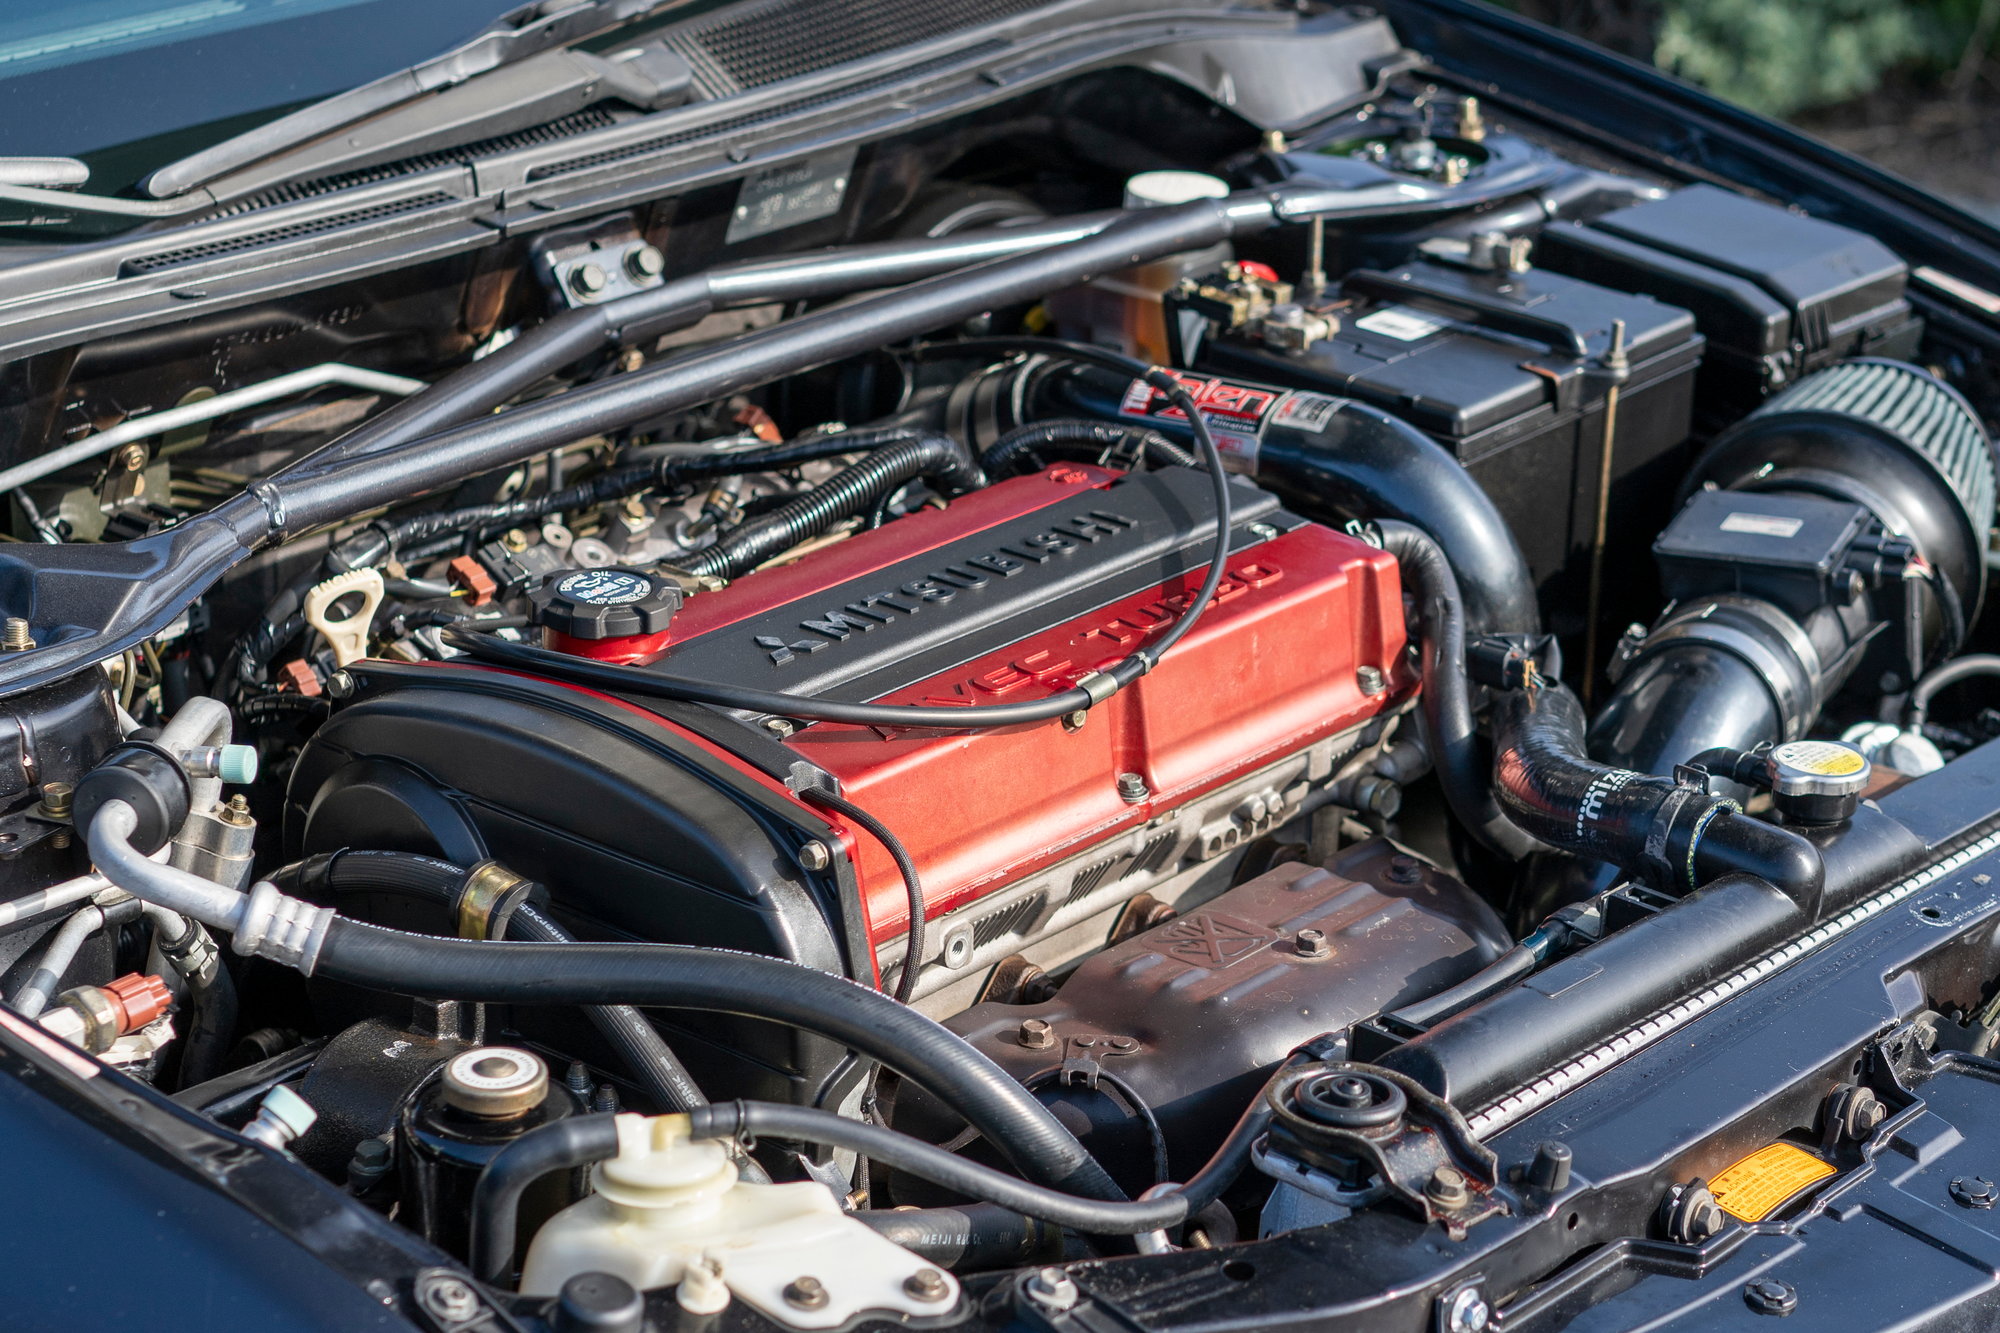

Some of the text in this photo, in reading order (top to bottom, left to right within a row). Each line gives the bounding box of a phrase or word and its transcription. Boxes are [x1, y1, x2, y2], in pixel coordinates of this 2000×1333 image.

[1152, 367, 1278, 421] njen
[560, 573, 588, 592] ENGINE
[800, 509, 1139, 641] MITSUBISHI
[920, 1233, 952, 1245] MEIJI
